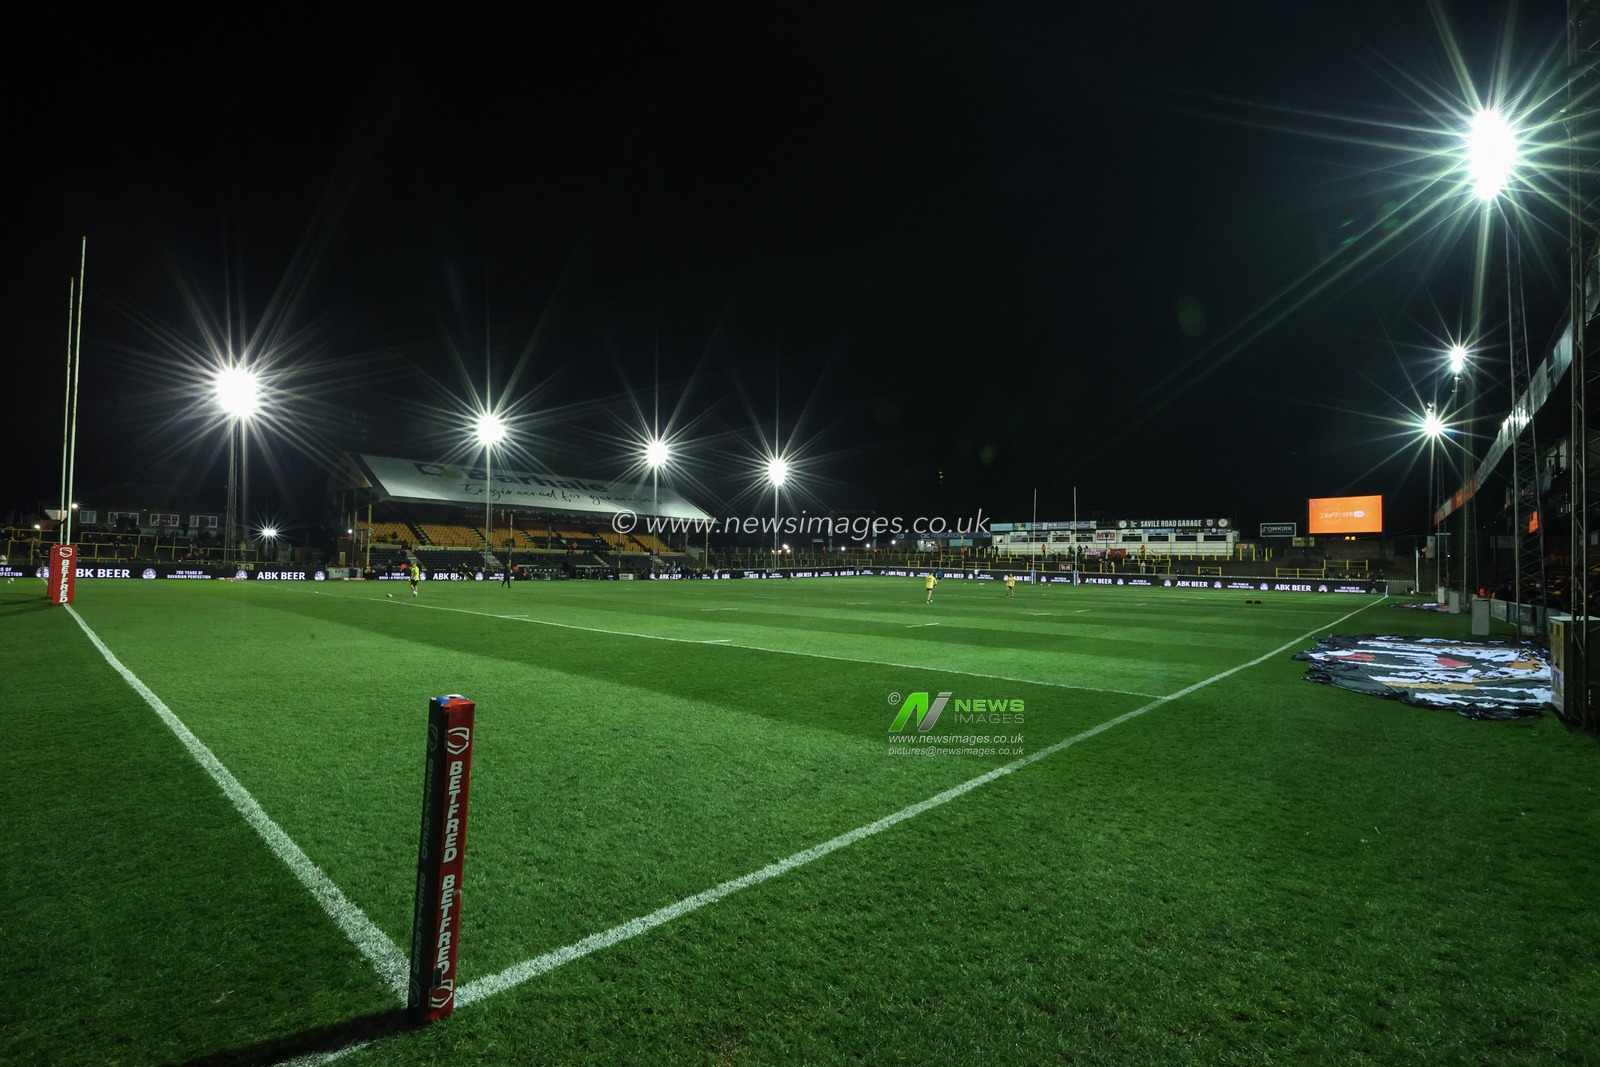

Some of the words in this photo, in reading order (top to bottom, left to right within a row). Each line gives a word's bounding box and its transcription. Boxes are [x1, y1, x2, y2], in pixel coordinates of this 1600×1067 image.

[1140, 520, 1160, 528] SAVILE
[1160, 519, 1177, 527] ROAD
[1177, 519, 1202, 527] GARAGE
[75, 568, 95, 578] BK
[97, 568, 131, 578] BEER
[256, 571, 279, 580] ABK
[280, 571, 306, 580] BEER
[433, 572, 449, 580] ABK
[59, 559, 70, 603] BETFRED
[443, 760, 463, 863] BETFRED
[437, 873, 456, 973] BETFRED
